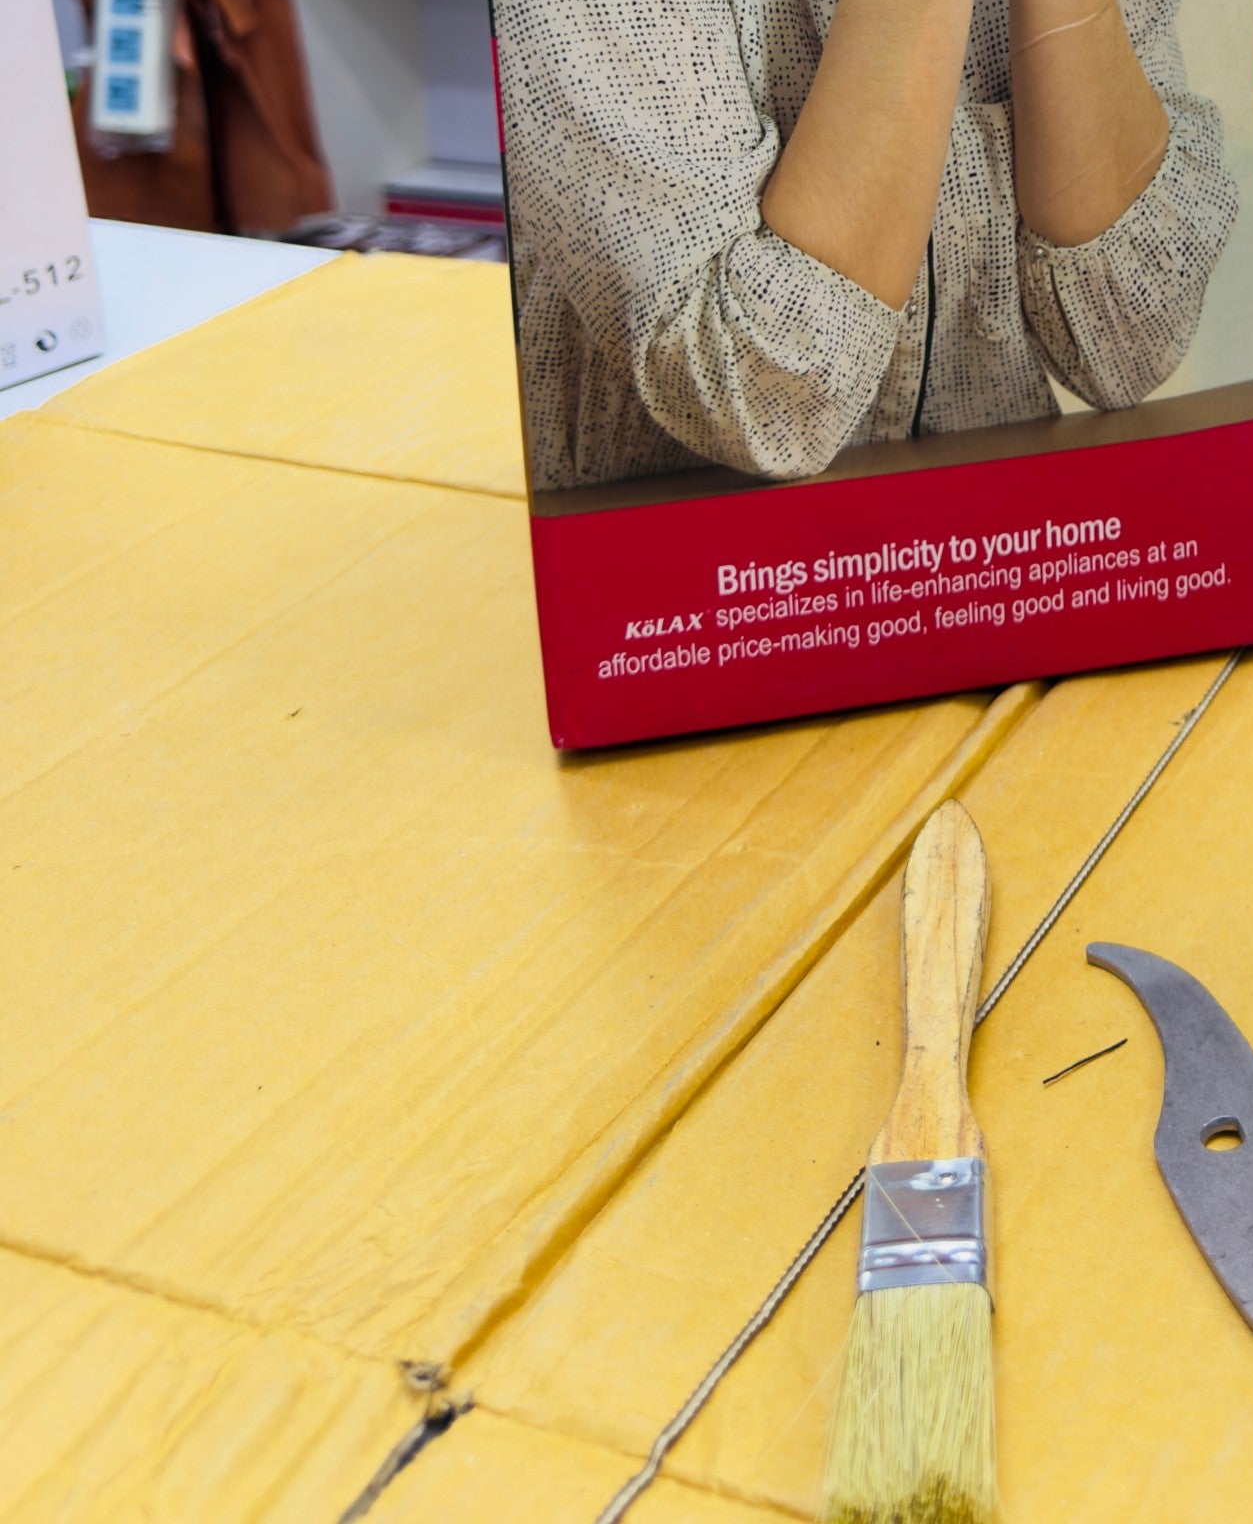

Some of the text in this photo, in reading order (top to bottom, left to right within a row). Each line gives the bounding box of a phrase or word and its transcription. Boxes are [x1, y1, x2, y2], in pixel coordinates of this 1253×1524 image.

[716, 592, 839, 630] specializes
[845, 585, 864, 609] in
[871, 564, 1022, 605] life-enhancing
[1029, 547, 1141, 583] appliances
[1147, 541, 1167, 564] at
[1173, 539, 1198, 560] an
[717, 516, 1122, 596] Brings simplicity to your home
[598, 562, 1232, 679] affordable price-making good, feeling good and living good.
